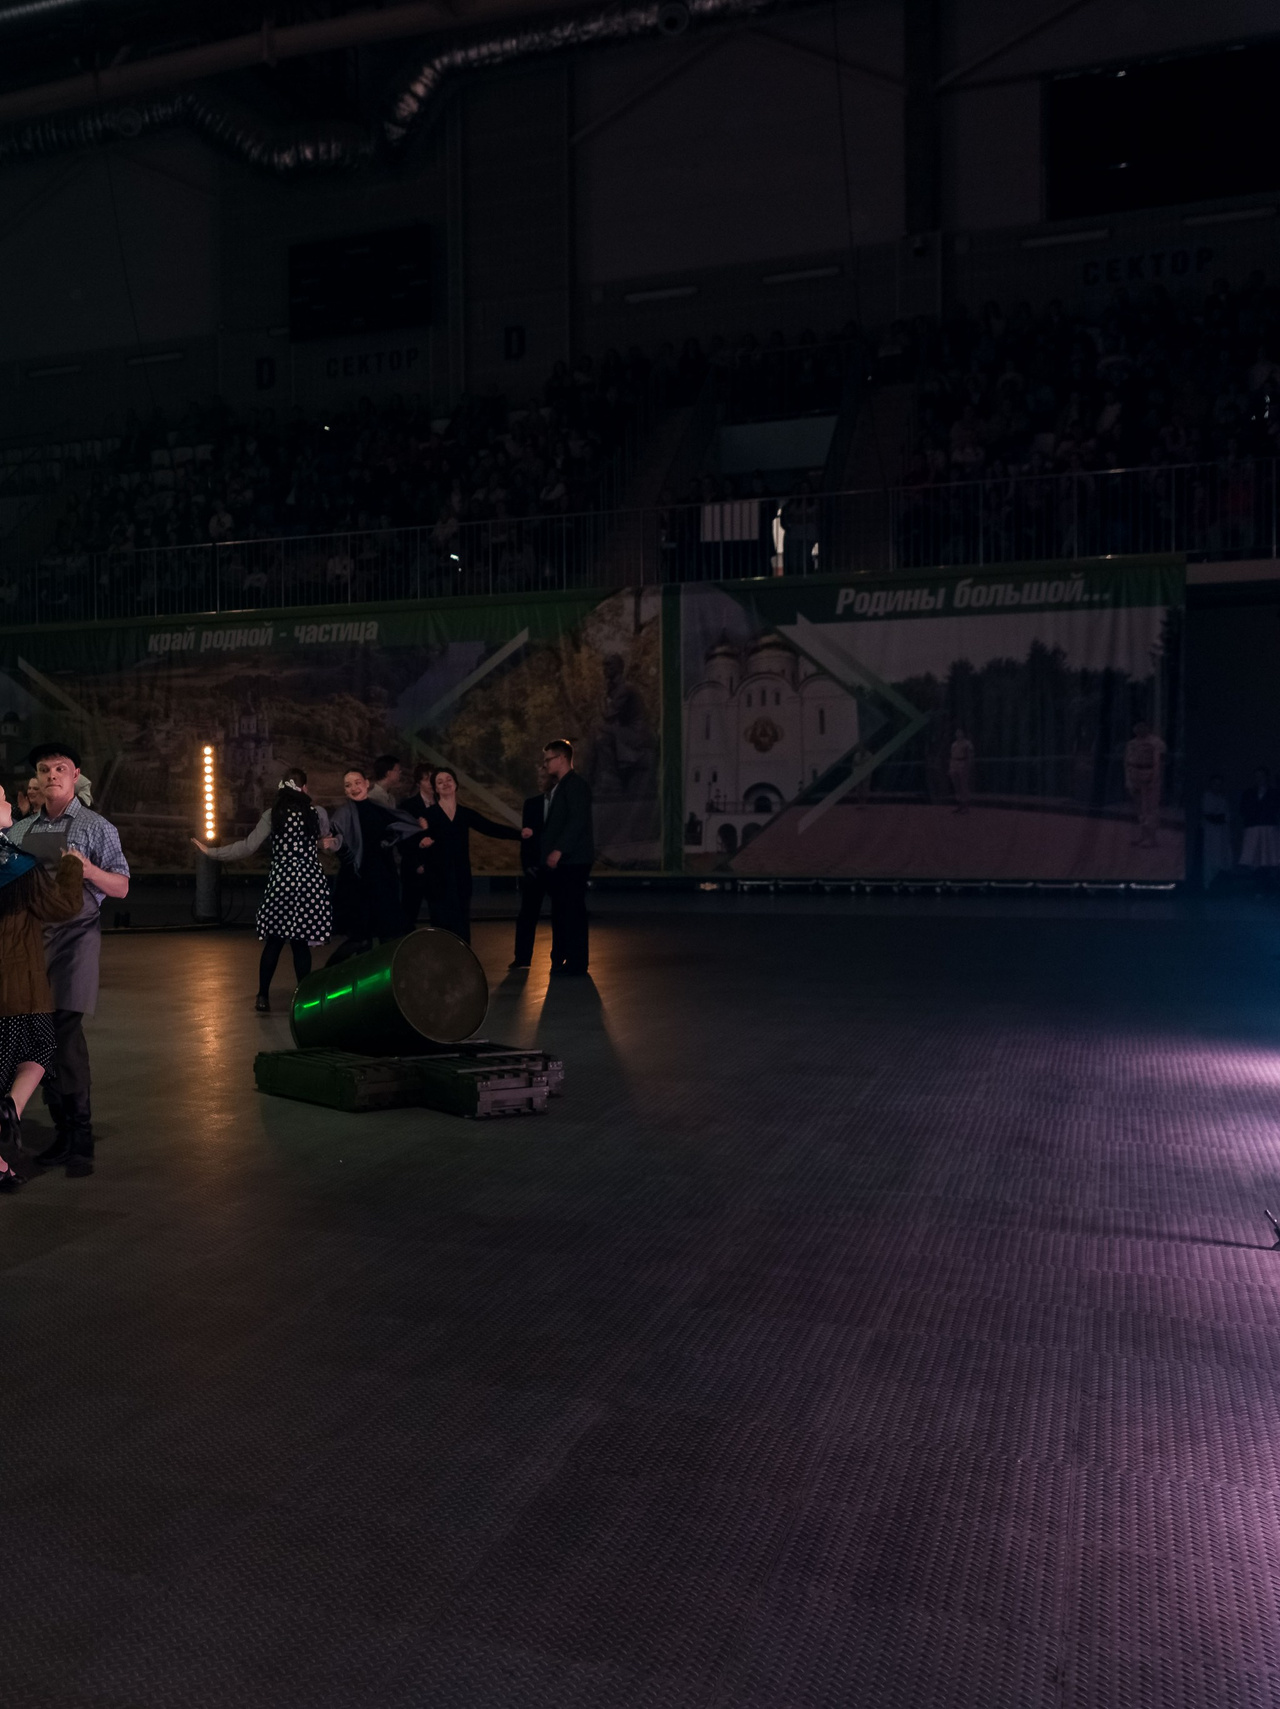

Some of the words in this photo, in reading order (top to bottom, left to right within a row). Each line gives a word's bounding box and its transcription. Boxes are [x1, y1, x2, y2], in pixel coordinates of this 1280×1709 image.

[1083, 248, 1213, 286] СЕКТОР
[326, 347, 419, 378] СЕКТОР
[835, 587, 946, 617] Родины
[953, 571, 1110, 608] большой...
[148, 627, 195, 655] край
[200, 621, 274, 652] родной
[294, 620, 379, 645] частица
